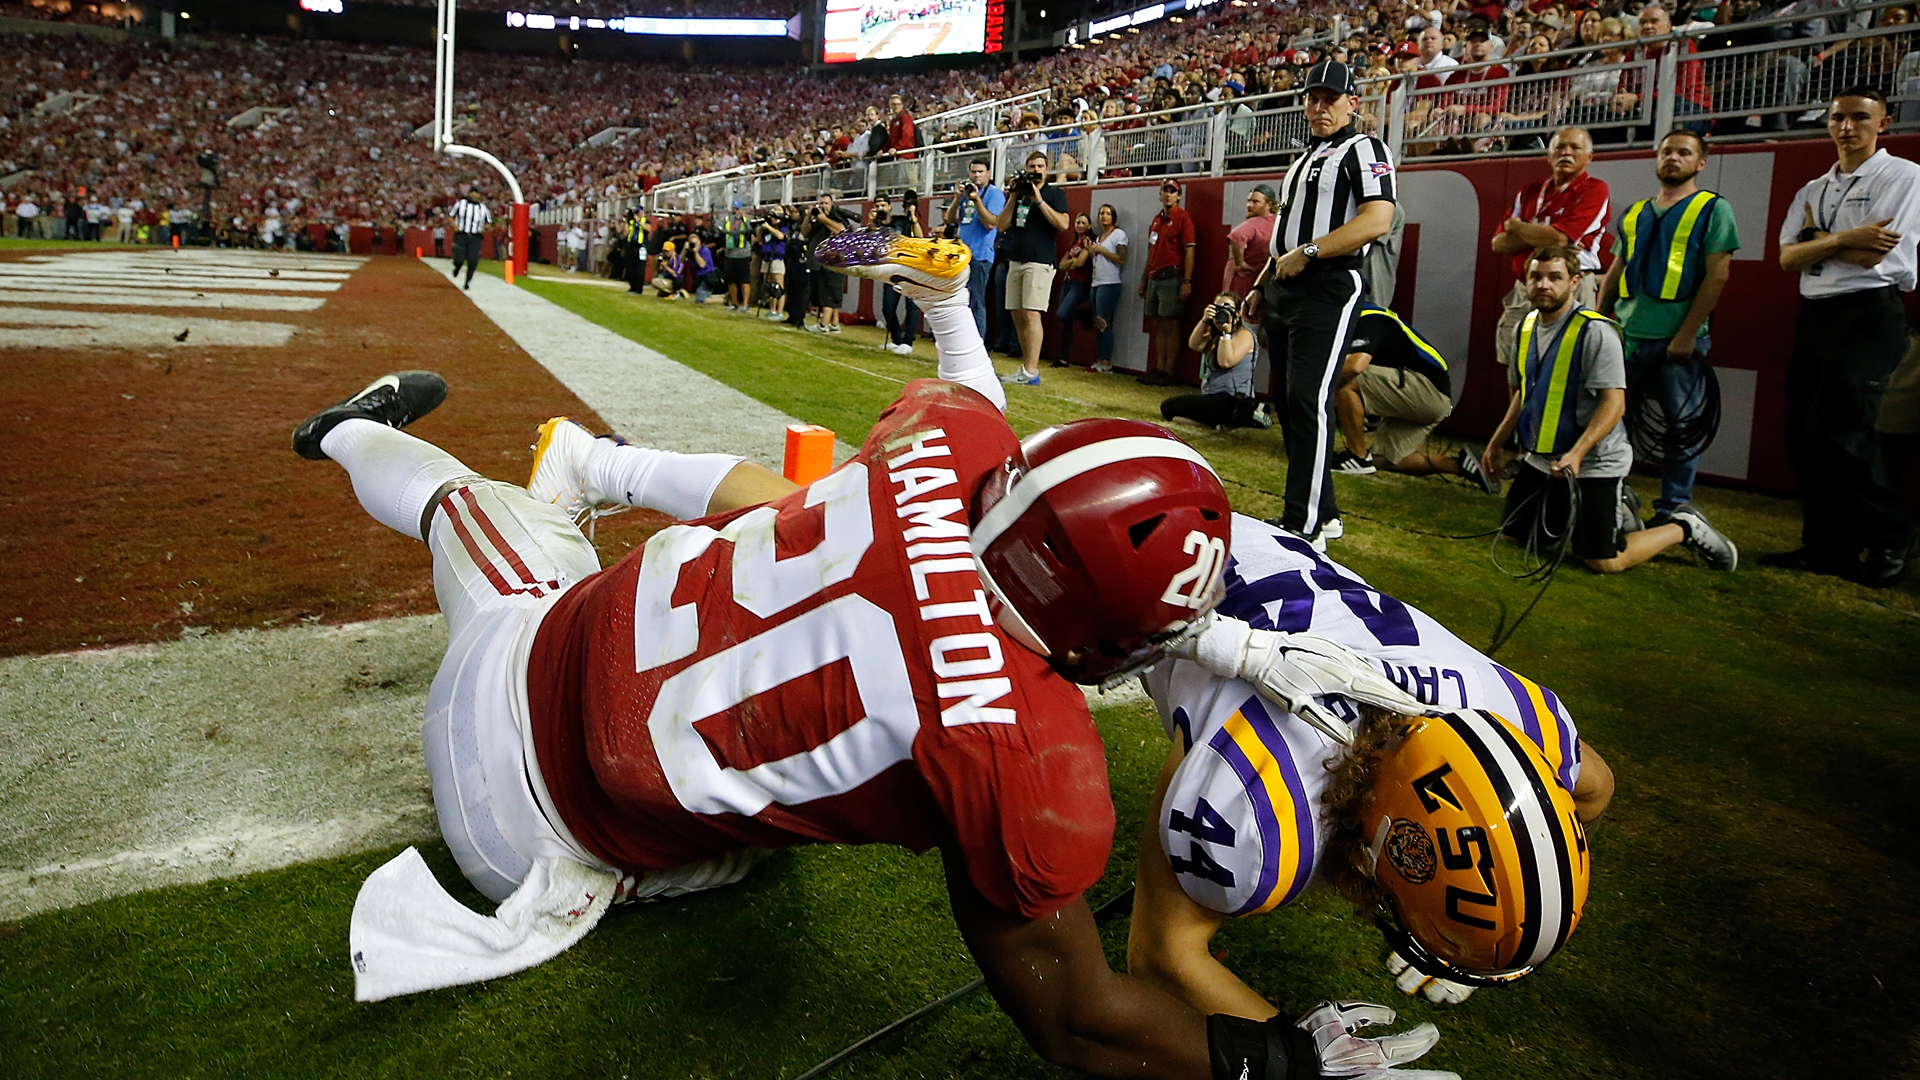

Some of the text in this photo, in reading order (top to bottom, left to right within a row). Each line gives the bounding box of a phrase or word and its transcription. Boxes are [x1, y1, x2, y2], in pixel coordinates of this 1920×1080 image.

[985, 0, 1004, 54] BAMA
[1308, 167, 1321, 182] F
[884, 428, 1017, 727] HAMILTON
[1160, 529, 1226, 610] 20
[634, 462, 922, 816] 20
[1168, 796, 1236, 888] 44
[1411, 762, 1497, 931] LSU
